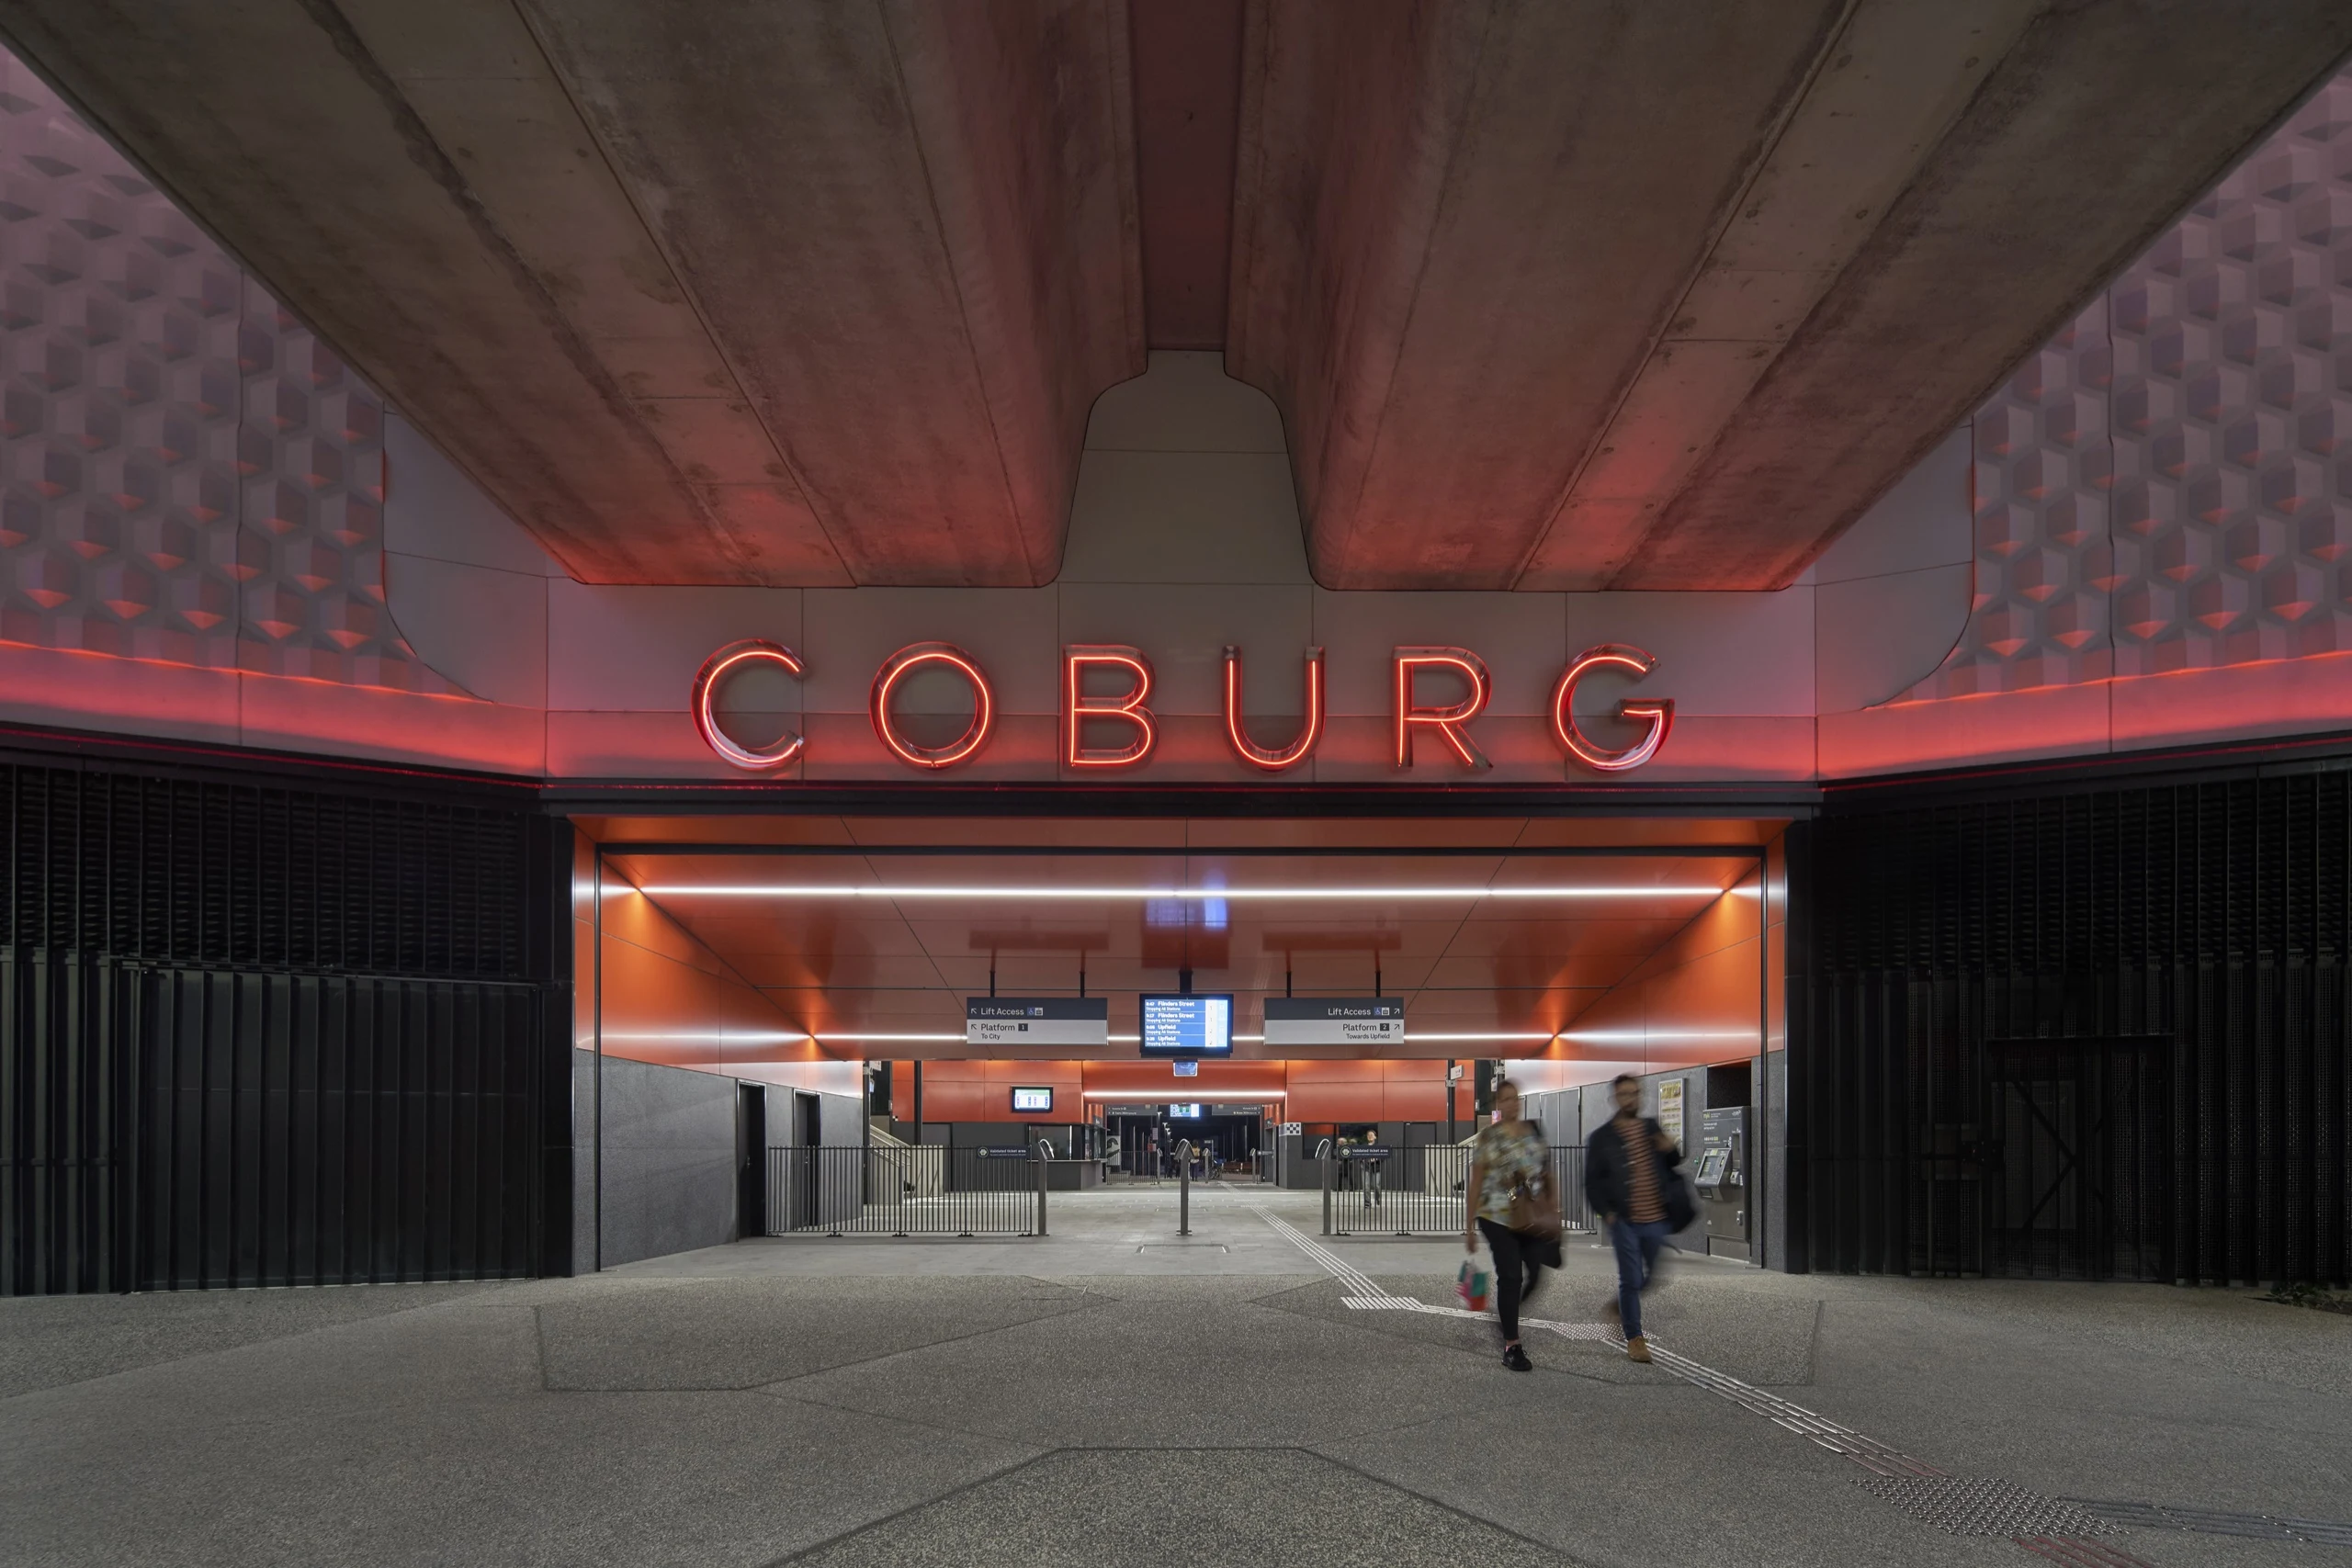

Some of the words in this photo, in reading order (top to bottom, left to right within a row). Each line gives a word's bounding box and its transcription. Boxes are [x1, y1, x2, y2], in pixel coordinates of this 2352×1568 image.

[691, 639, 1674, 771] COBURG
[980, 1007, 995, 1016] Lift
[996, 1008, 1024, 1016] Access
[1328, 1008, 1342, 1016] Lift
[1343, 1008, 1372, 1016] Access
[980, 1023, 1015, 1032] Platform
[1342, 1023, 1377, 1032] Platform
